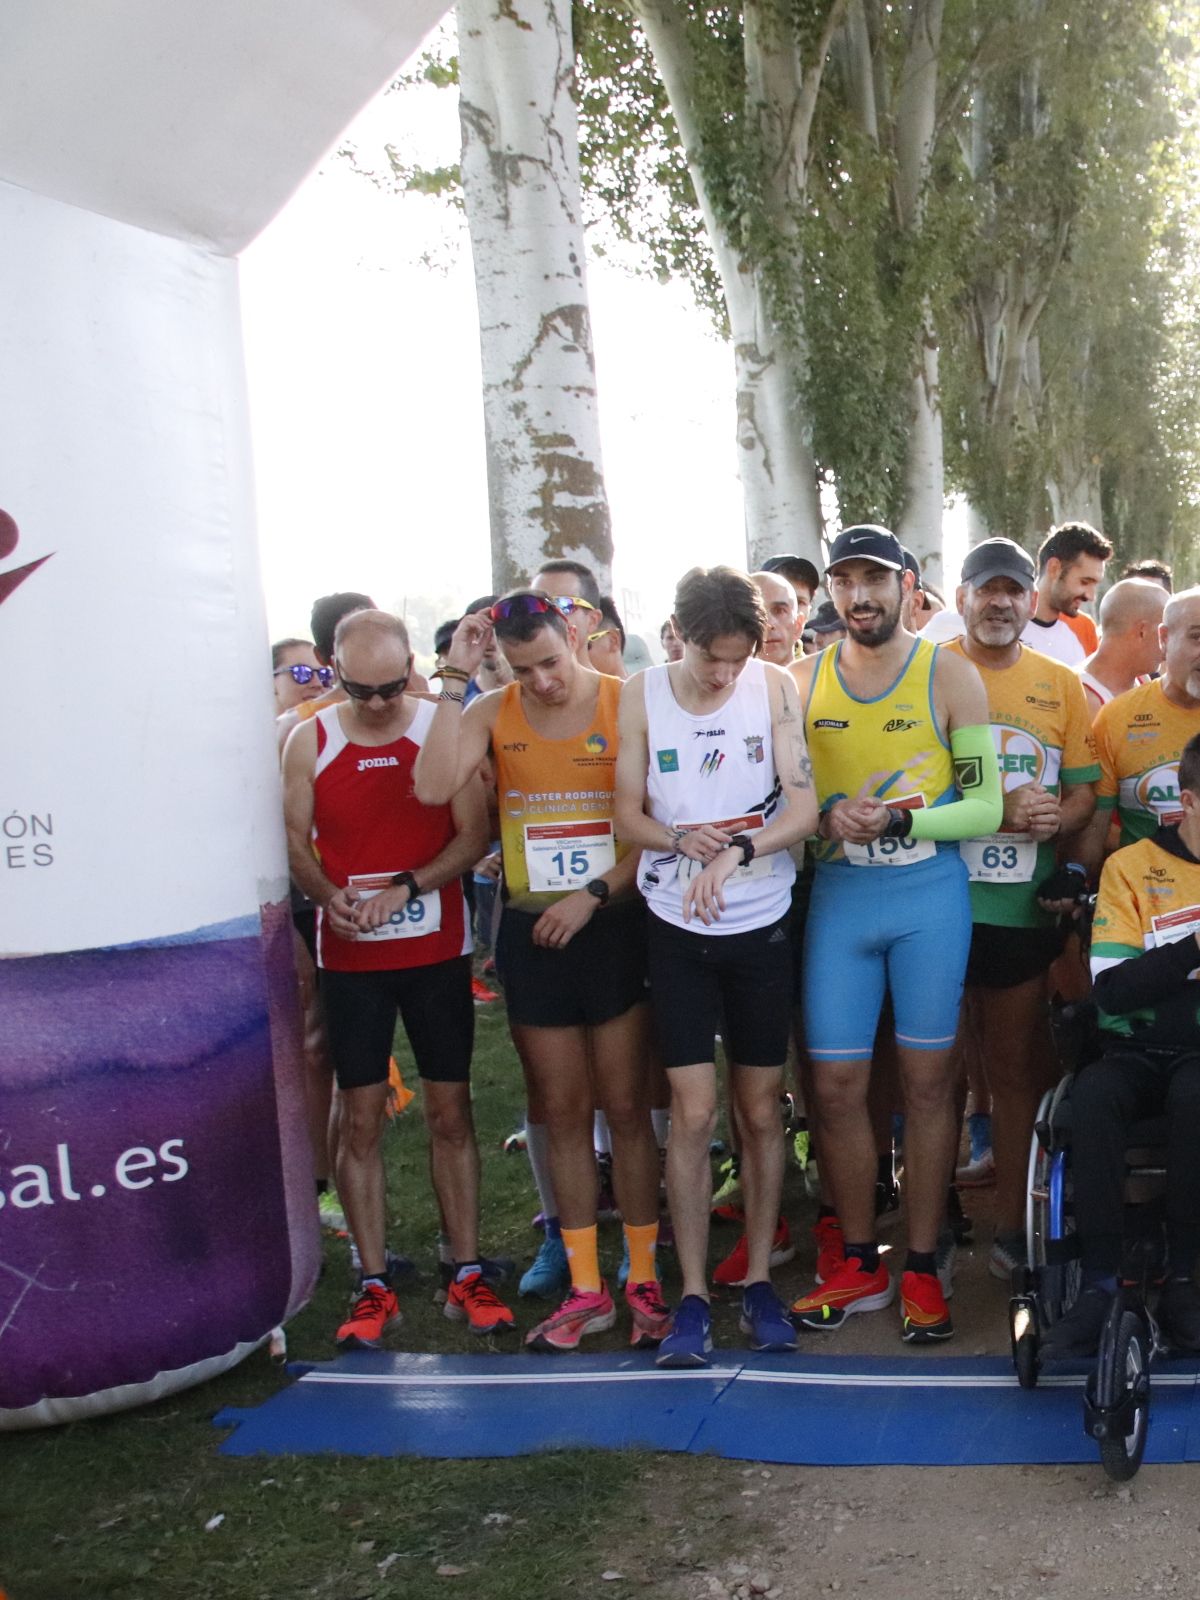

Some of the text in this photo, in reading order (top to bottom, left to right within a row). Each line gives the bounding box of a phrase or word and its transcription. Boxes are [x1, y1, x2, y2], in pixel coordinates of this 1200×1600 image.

[528, 792, 562, 802] ESTER
[6, 843, 54, 869] ES
[551, 850, 589, 876] 15
[982, 845, 1018, 869] 63
